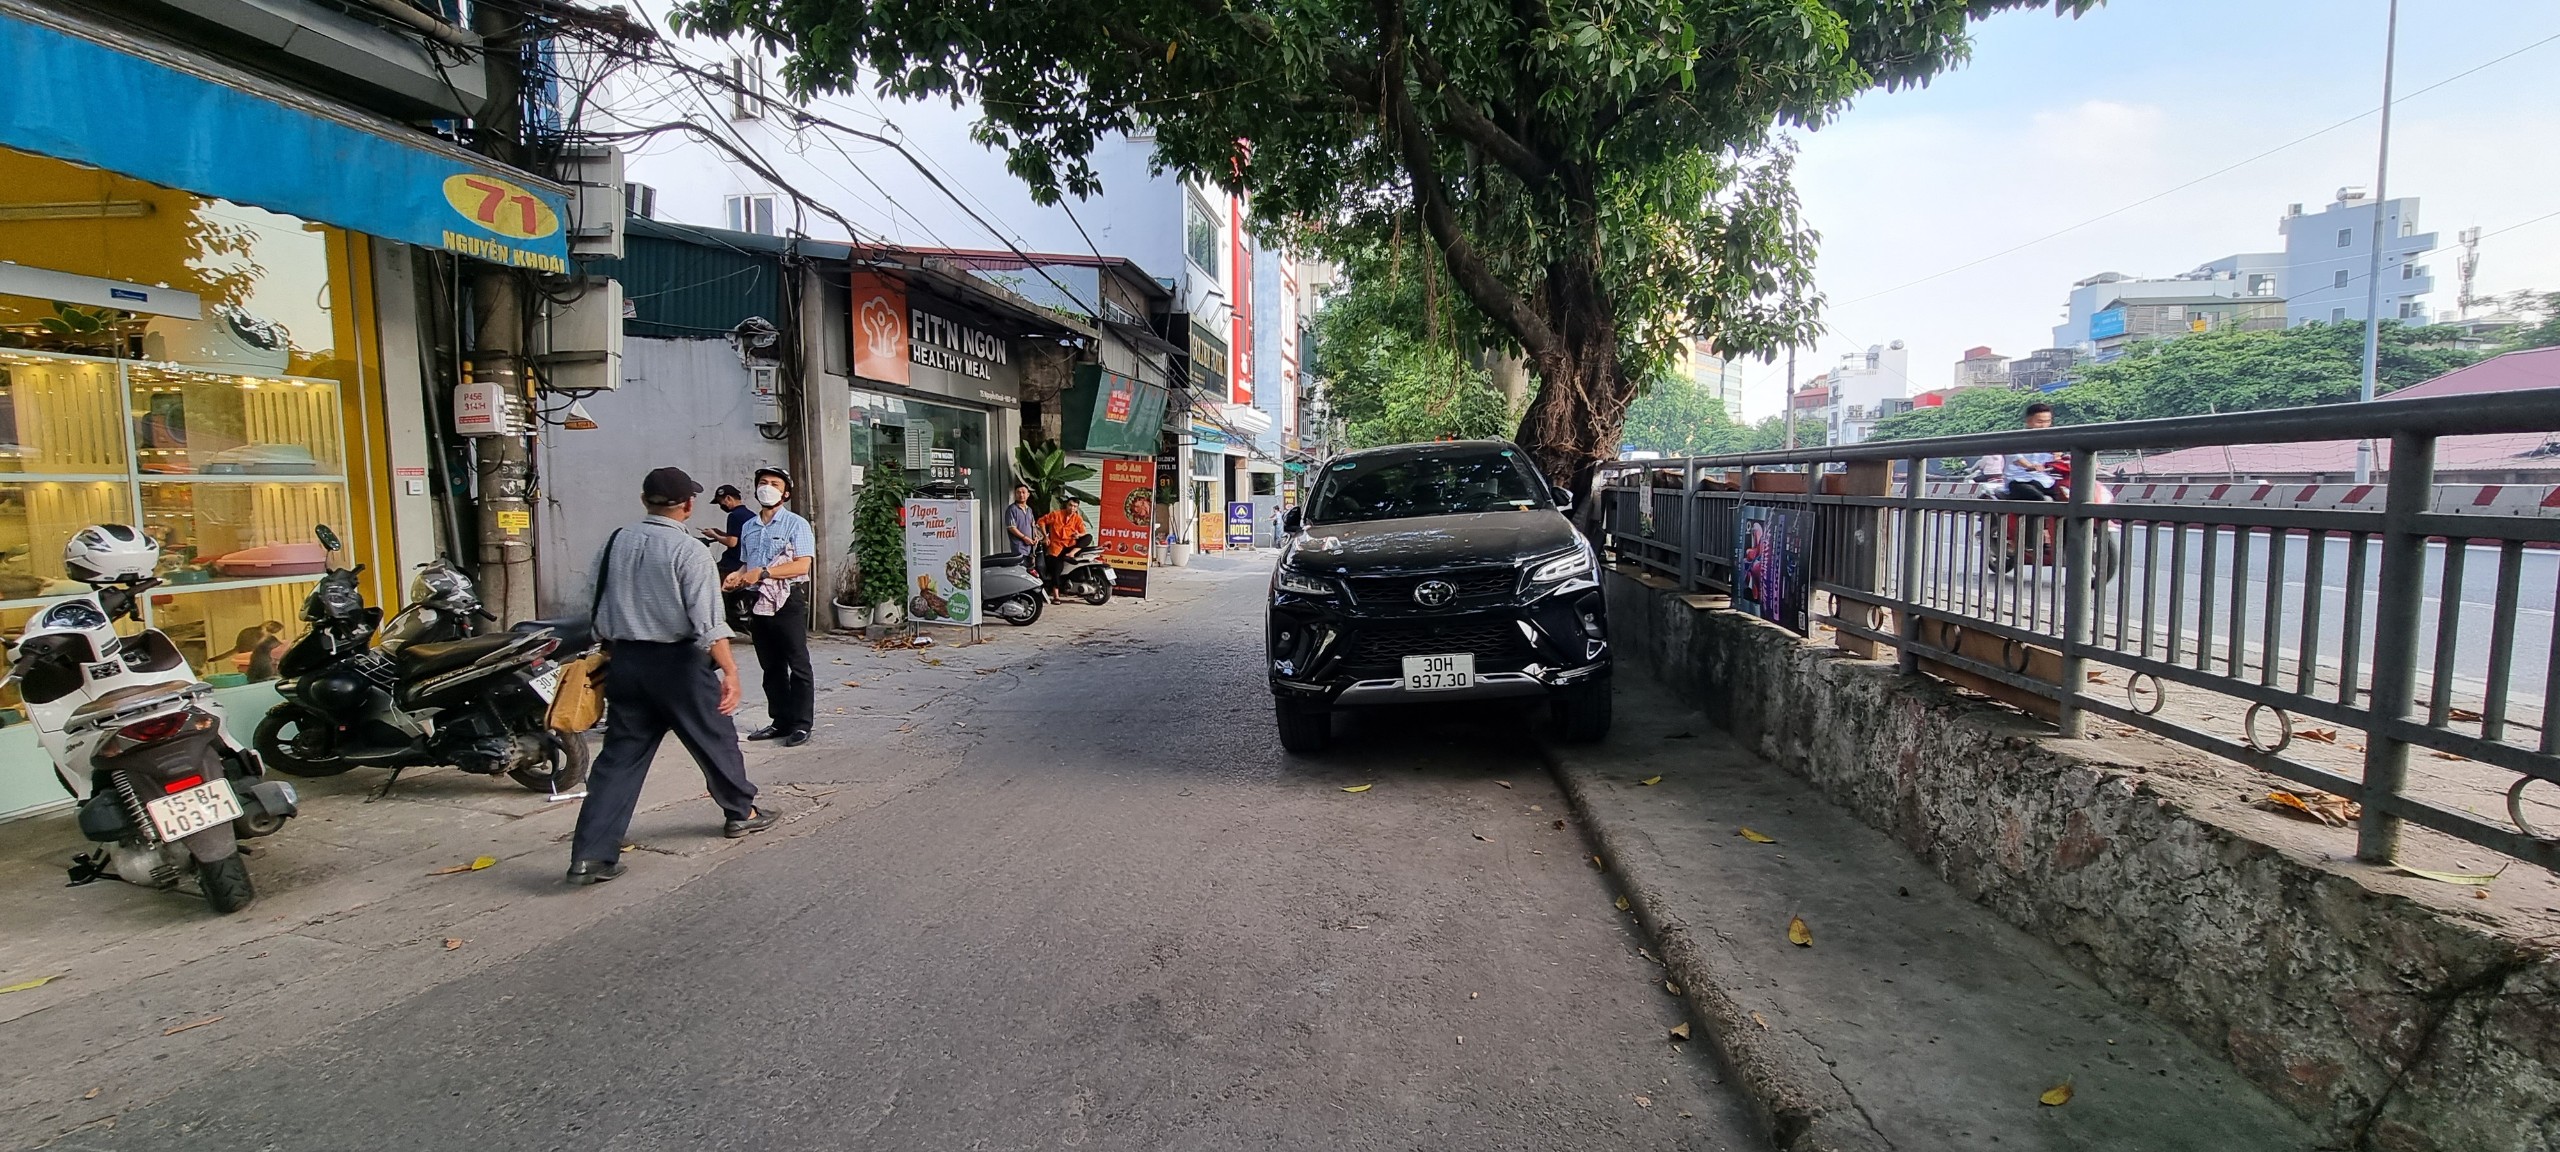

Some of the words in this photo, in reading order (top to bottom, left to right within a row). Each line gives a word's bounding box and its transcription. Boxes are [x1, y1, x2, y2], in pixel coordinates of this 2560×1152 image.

[464, 178, 537, 235] 71
[442, 230, 508, 263] NGUYỄN
[513, 249, 565, 275] KHOÁI
[912, 308, 959, 351] FIT'N
[963, 326, 1007, 365] NGON
[913, 344, 962, 372] HEALTHY
[965, 359, 991, 380] MEAL
[910, 504, 938, 519] Ngon
[1131, 530, 1148, 539] 19K
[1230, 524, 1252, 535] HOTEL
[1412, 672, 1466, 688] 937.30
[1424, 657, 1453, 672] 30H
[163, 785, 220, 816] 15-B4
[164, 799, 236, 836] 403.71
